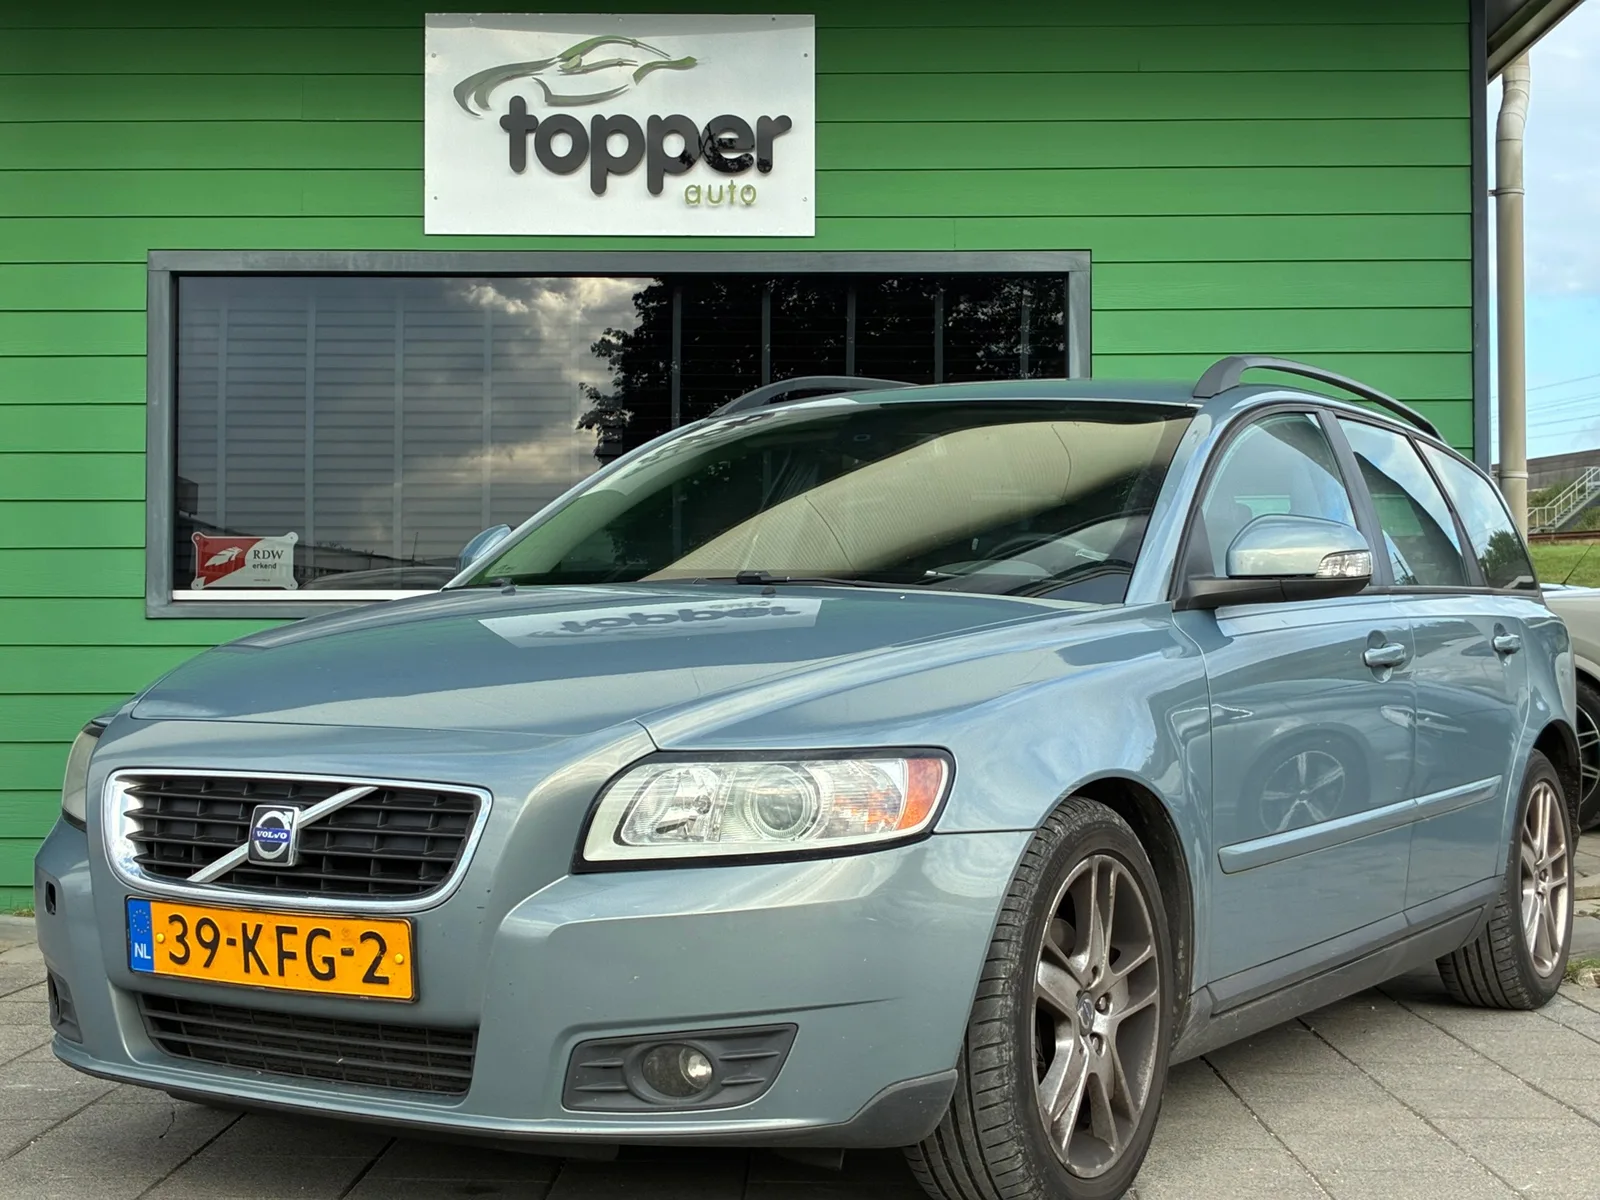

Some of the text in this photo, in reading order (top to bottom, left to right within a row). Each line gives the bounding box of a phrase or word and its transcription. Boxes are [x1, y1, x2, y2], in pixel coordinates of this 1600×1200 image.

[499, 95, 792, 195] topper
[684, 179, 757, 207] auto
[253, 550, 283, 559] RDW
[256, 830, 288, 840] VOLVO
[134, 942, 151, 960] NL
[168, 913, 390, 985] 39-KFG-2
